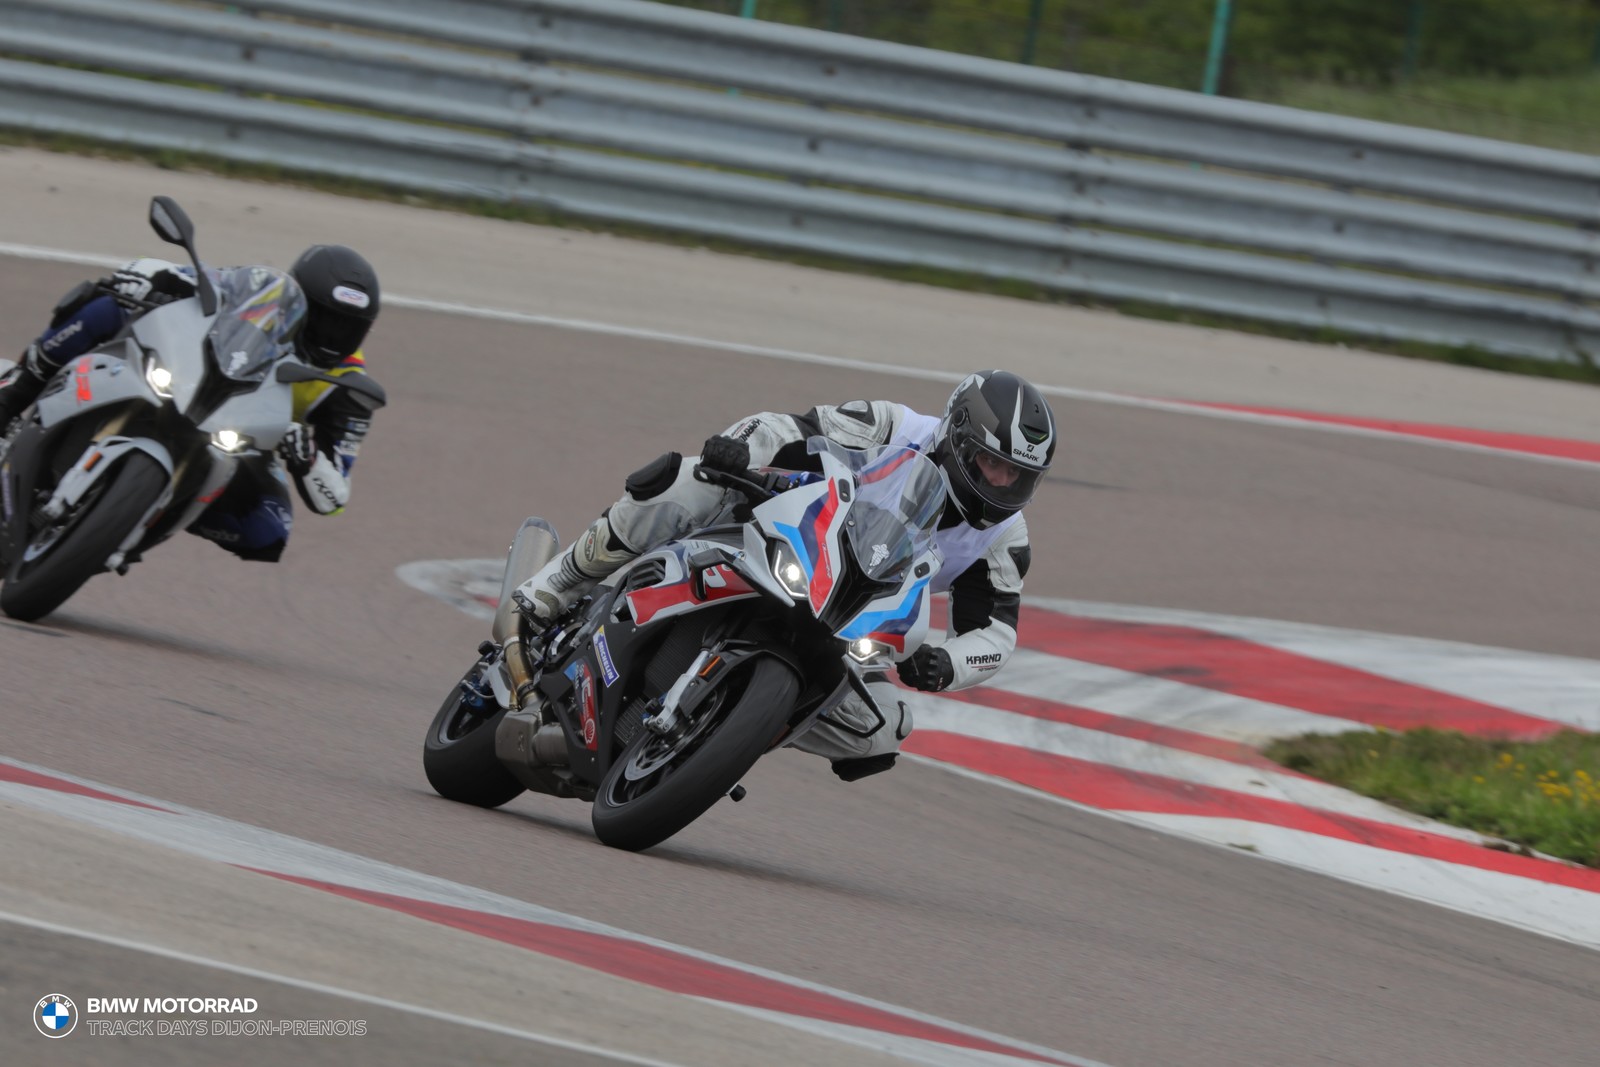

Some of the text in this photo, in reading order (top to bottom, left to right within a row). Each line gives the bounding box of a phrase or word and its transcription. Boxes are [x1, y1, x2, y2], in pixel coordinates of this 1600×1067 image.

[1012, 448, 1040, 462] SHARK
[598, 640, 614, 680] MICHELIN
[965, 652, 1002, 665] KARNO
